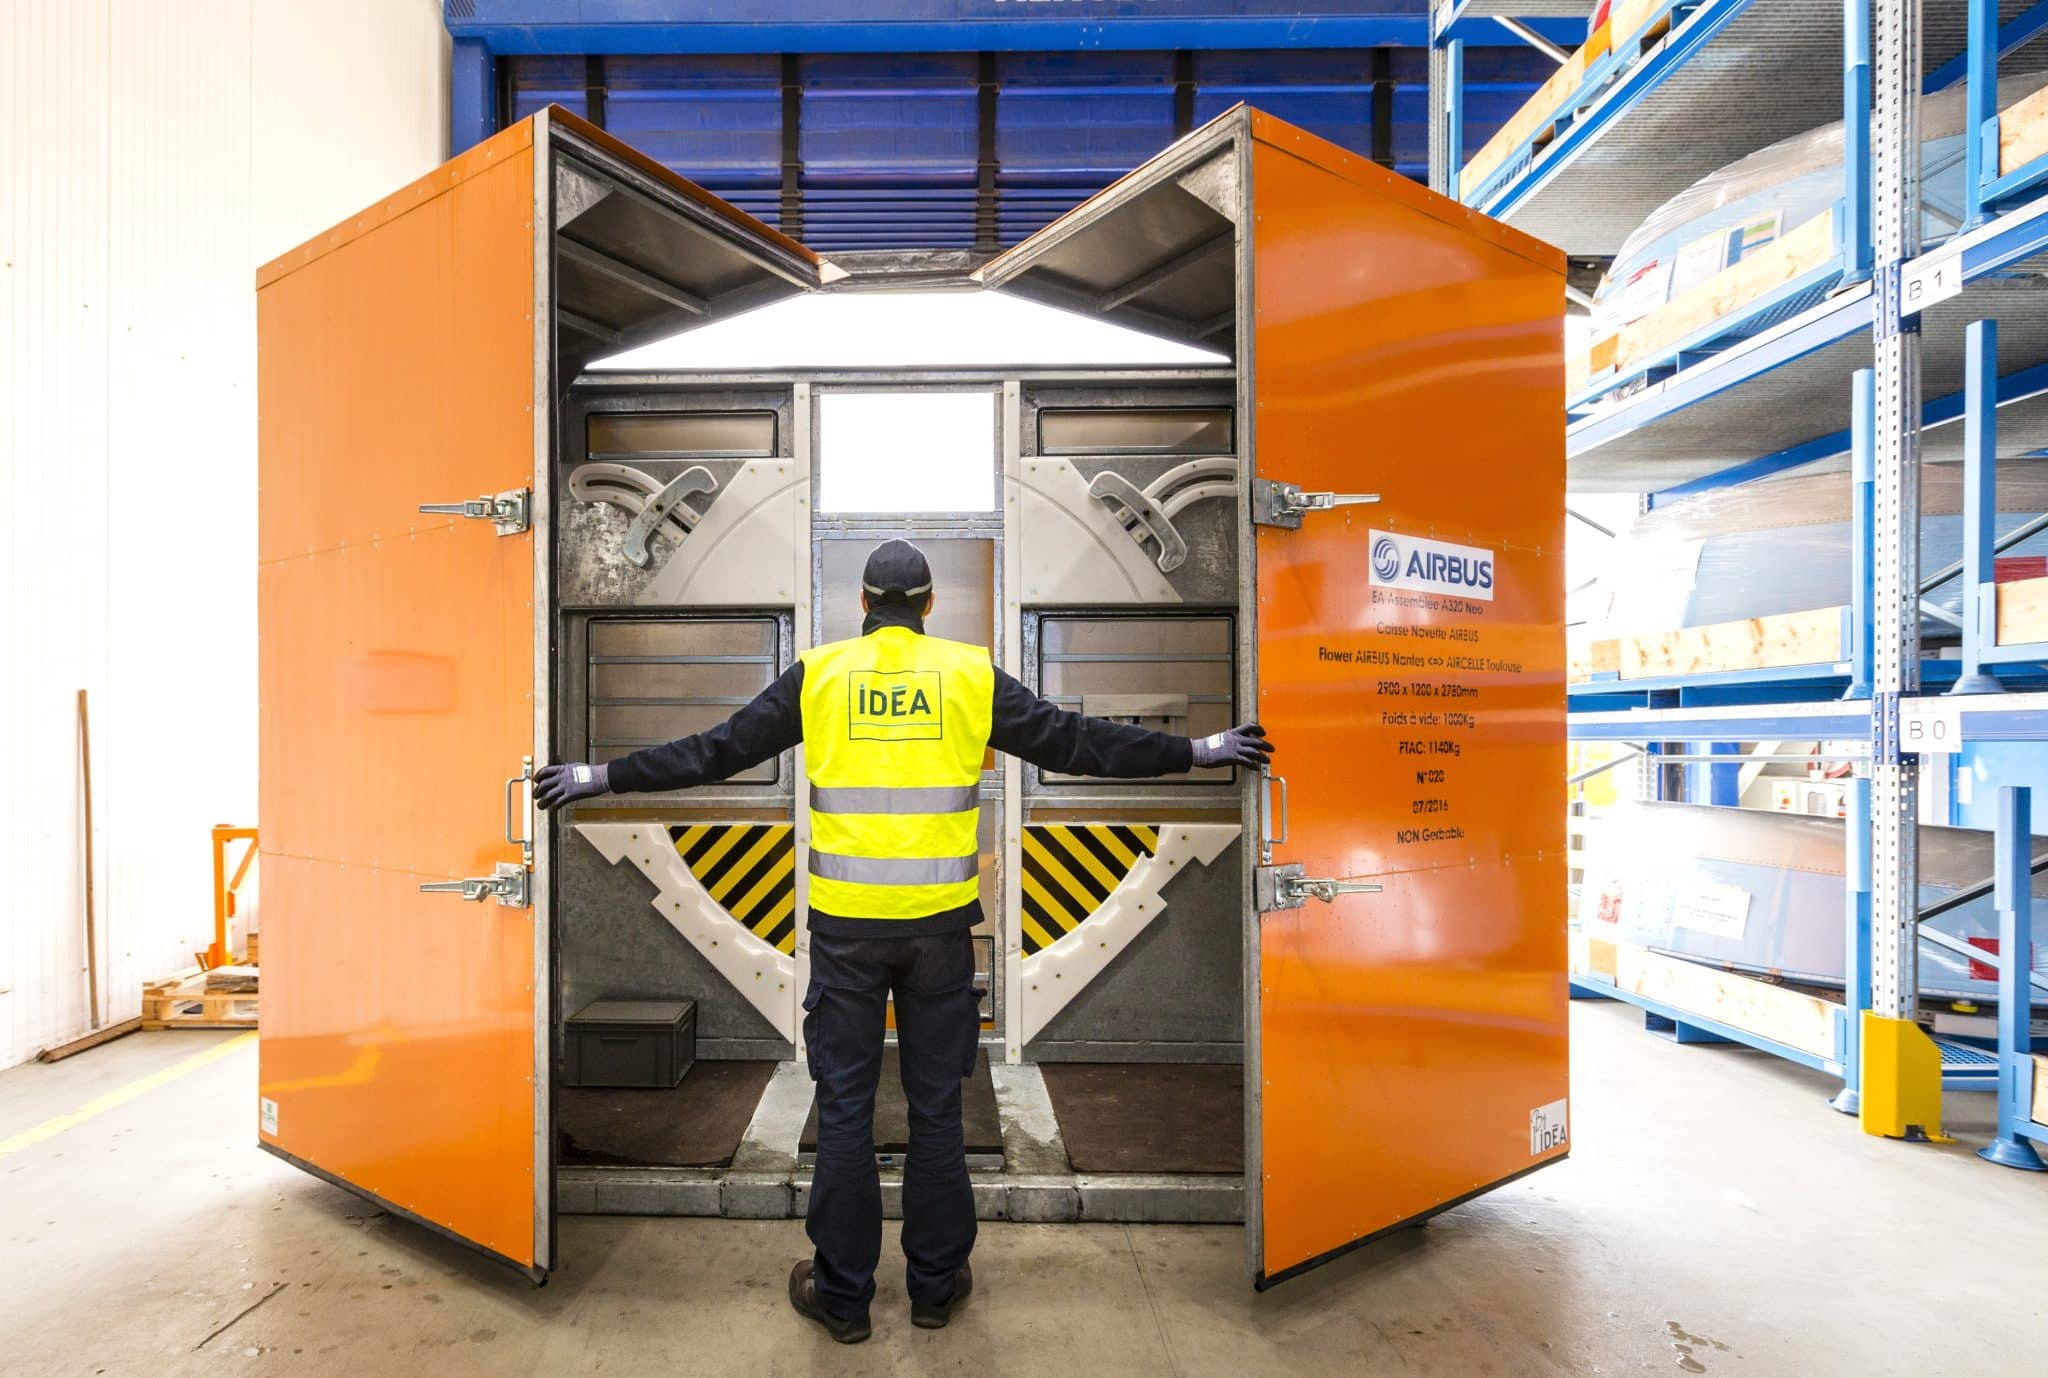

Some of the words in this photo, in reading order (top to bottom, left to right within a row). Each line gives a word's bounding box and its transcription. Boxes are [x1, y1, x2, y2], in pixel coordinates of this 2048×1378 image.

[1909, 280, 1922, 301] B
[1934, 269, 1941, 288] 1
[1406, 550, 1492, 589] AIRBUS
[1372, 590, 1385, 605] EA
[1441, 599, 1464, 613] A320
[1465, 601, 1483, 614] Neo
[1376, 621, 1409, 636] Caisse
[1411, 624, 1447, 640] Navette
[1449, 628, 1479, 642] AIRBUS
[1319, 646, 1353, 663] Flower
[1355, 650, 1390, 665] AIRBUS
[1392, 652, 1425, 667] Nantes
[1446, 657, 1486, 671] AIRCELLE
[1487, 658, 1522, 673] Toulouse
[1377, 681, 1401, 697] 2900
[1402, 686, 1408, 697] x
[1411, 682, 1432, 697] 1200
[1433, 687, 1440, 697] x
[1382, 711, 1408, 726] Poids
[1418, 712, 1440, 726] vide:
[1443, 713, 1475, 729] 1000Kg
[1910, 720, 1924, 740] B
[1399, 741, 1426, 755] PTAC:
[1429, 741, 1461, 757] 1140Kg
[1412, 799, 1449, 815] 07/2016
[1396, 829, 1420, 844] NON
[1422, 825, 1465, 842] Gerbable
